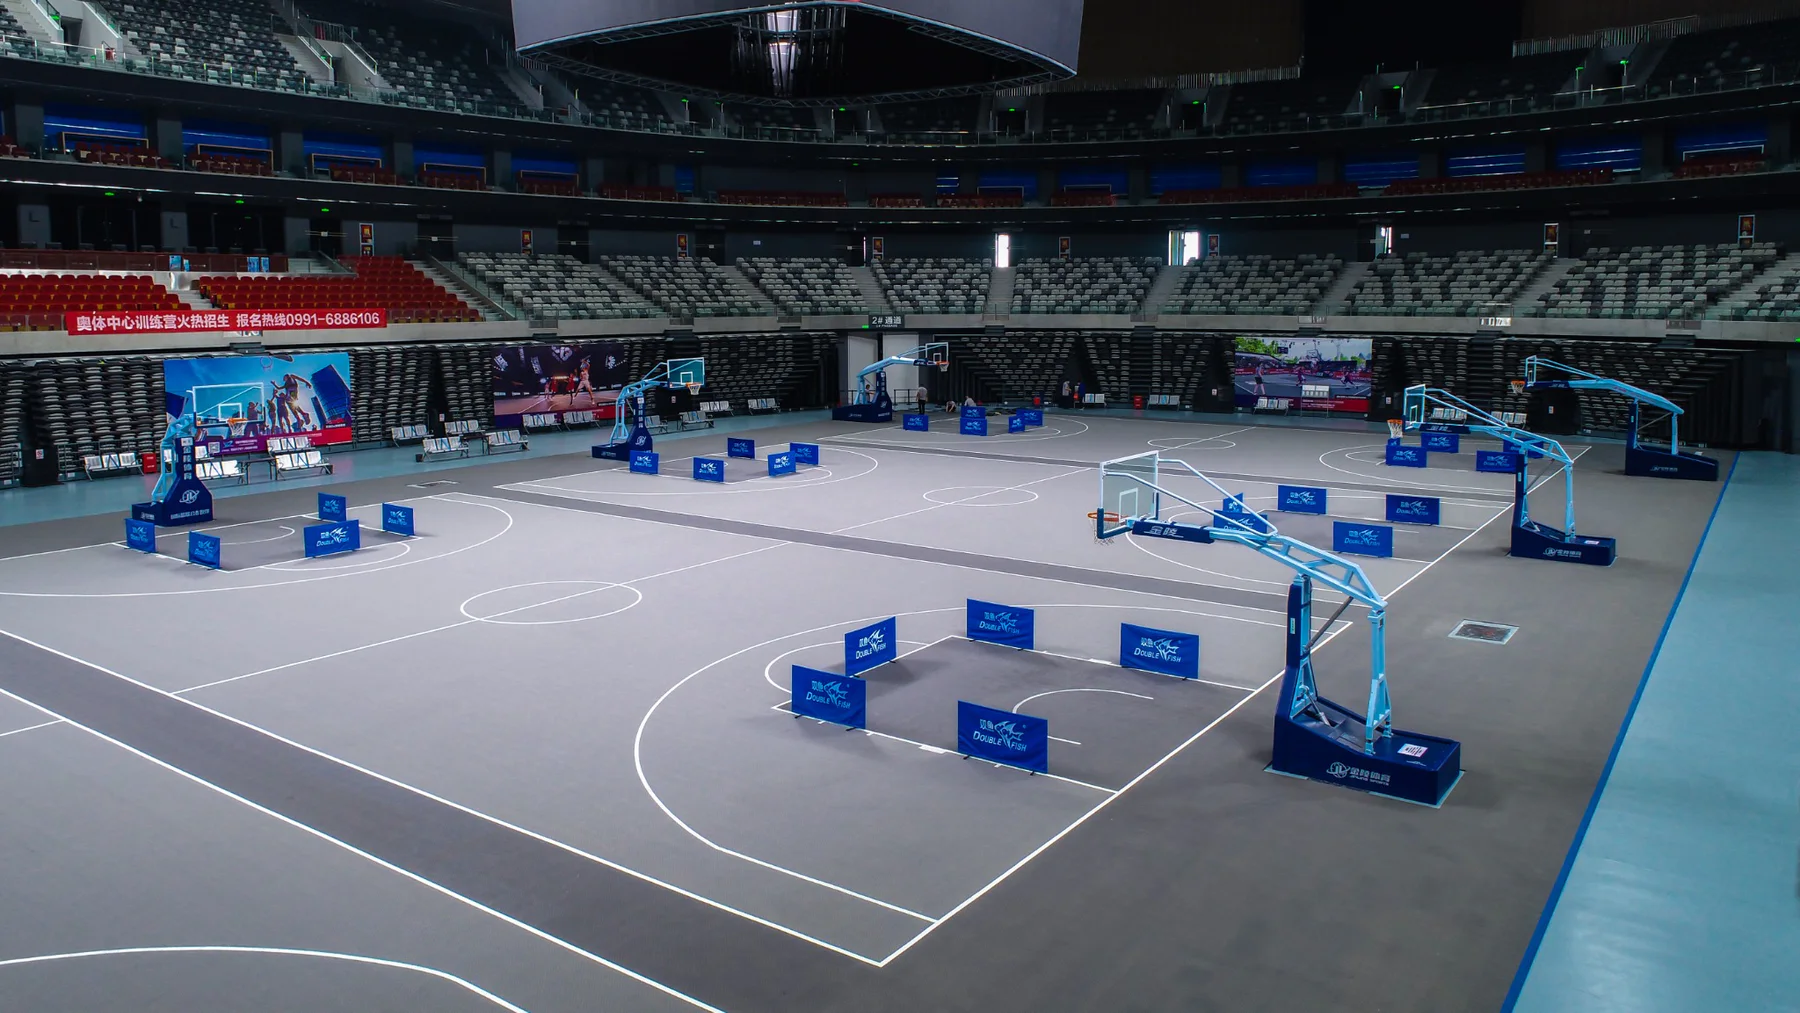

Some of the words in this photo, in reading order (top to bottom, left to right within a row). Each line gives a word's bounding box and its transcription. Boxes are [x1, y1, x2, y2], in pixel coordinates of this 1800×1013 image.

[76, 314, 229, 331] 奥体中心训练营火热招生
[236, 312, 380, 327] 报名热线0991-6886106
[885, 316, 902, 324] 通道
[979, 621, 1001, 631] DOUBLE
[855, 648, 873, 660] DOUBLE
[1133, 647, 1160, 659] DOUBLE
[806, 691, 830, 705] DOUBLE
[972, 731, 1003, 746] DOUBLE
[1011, 742, 1027, 752] FISH
